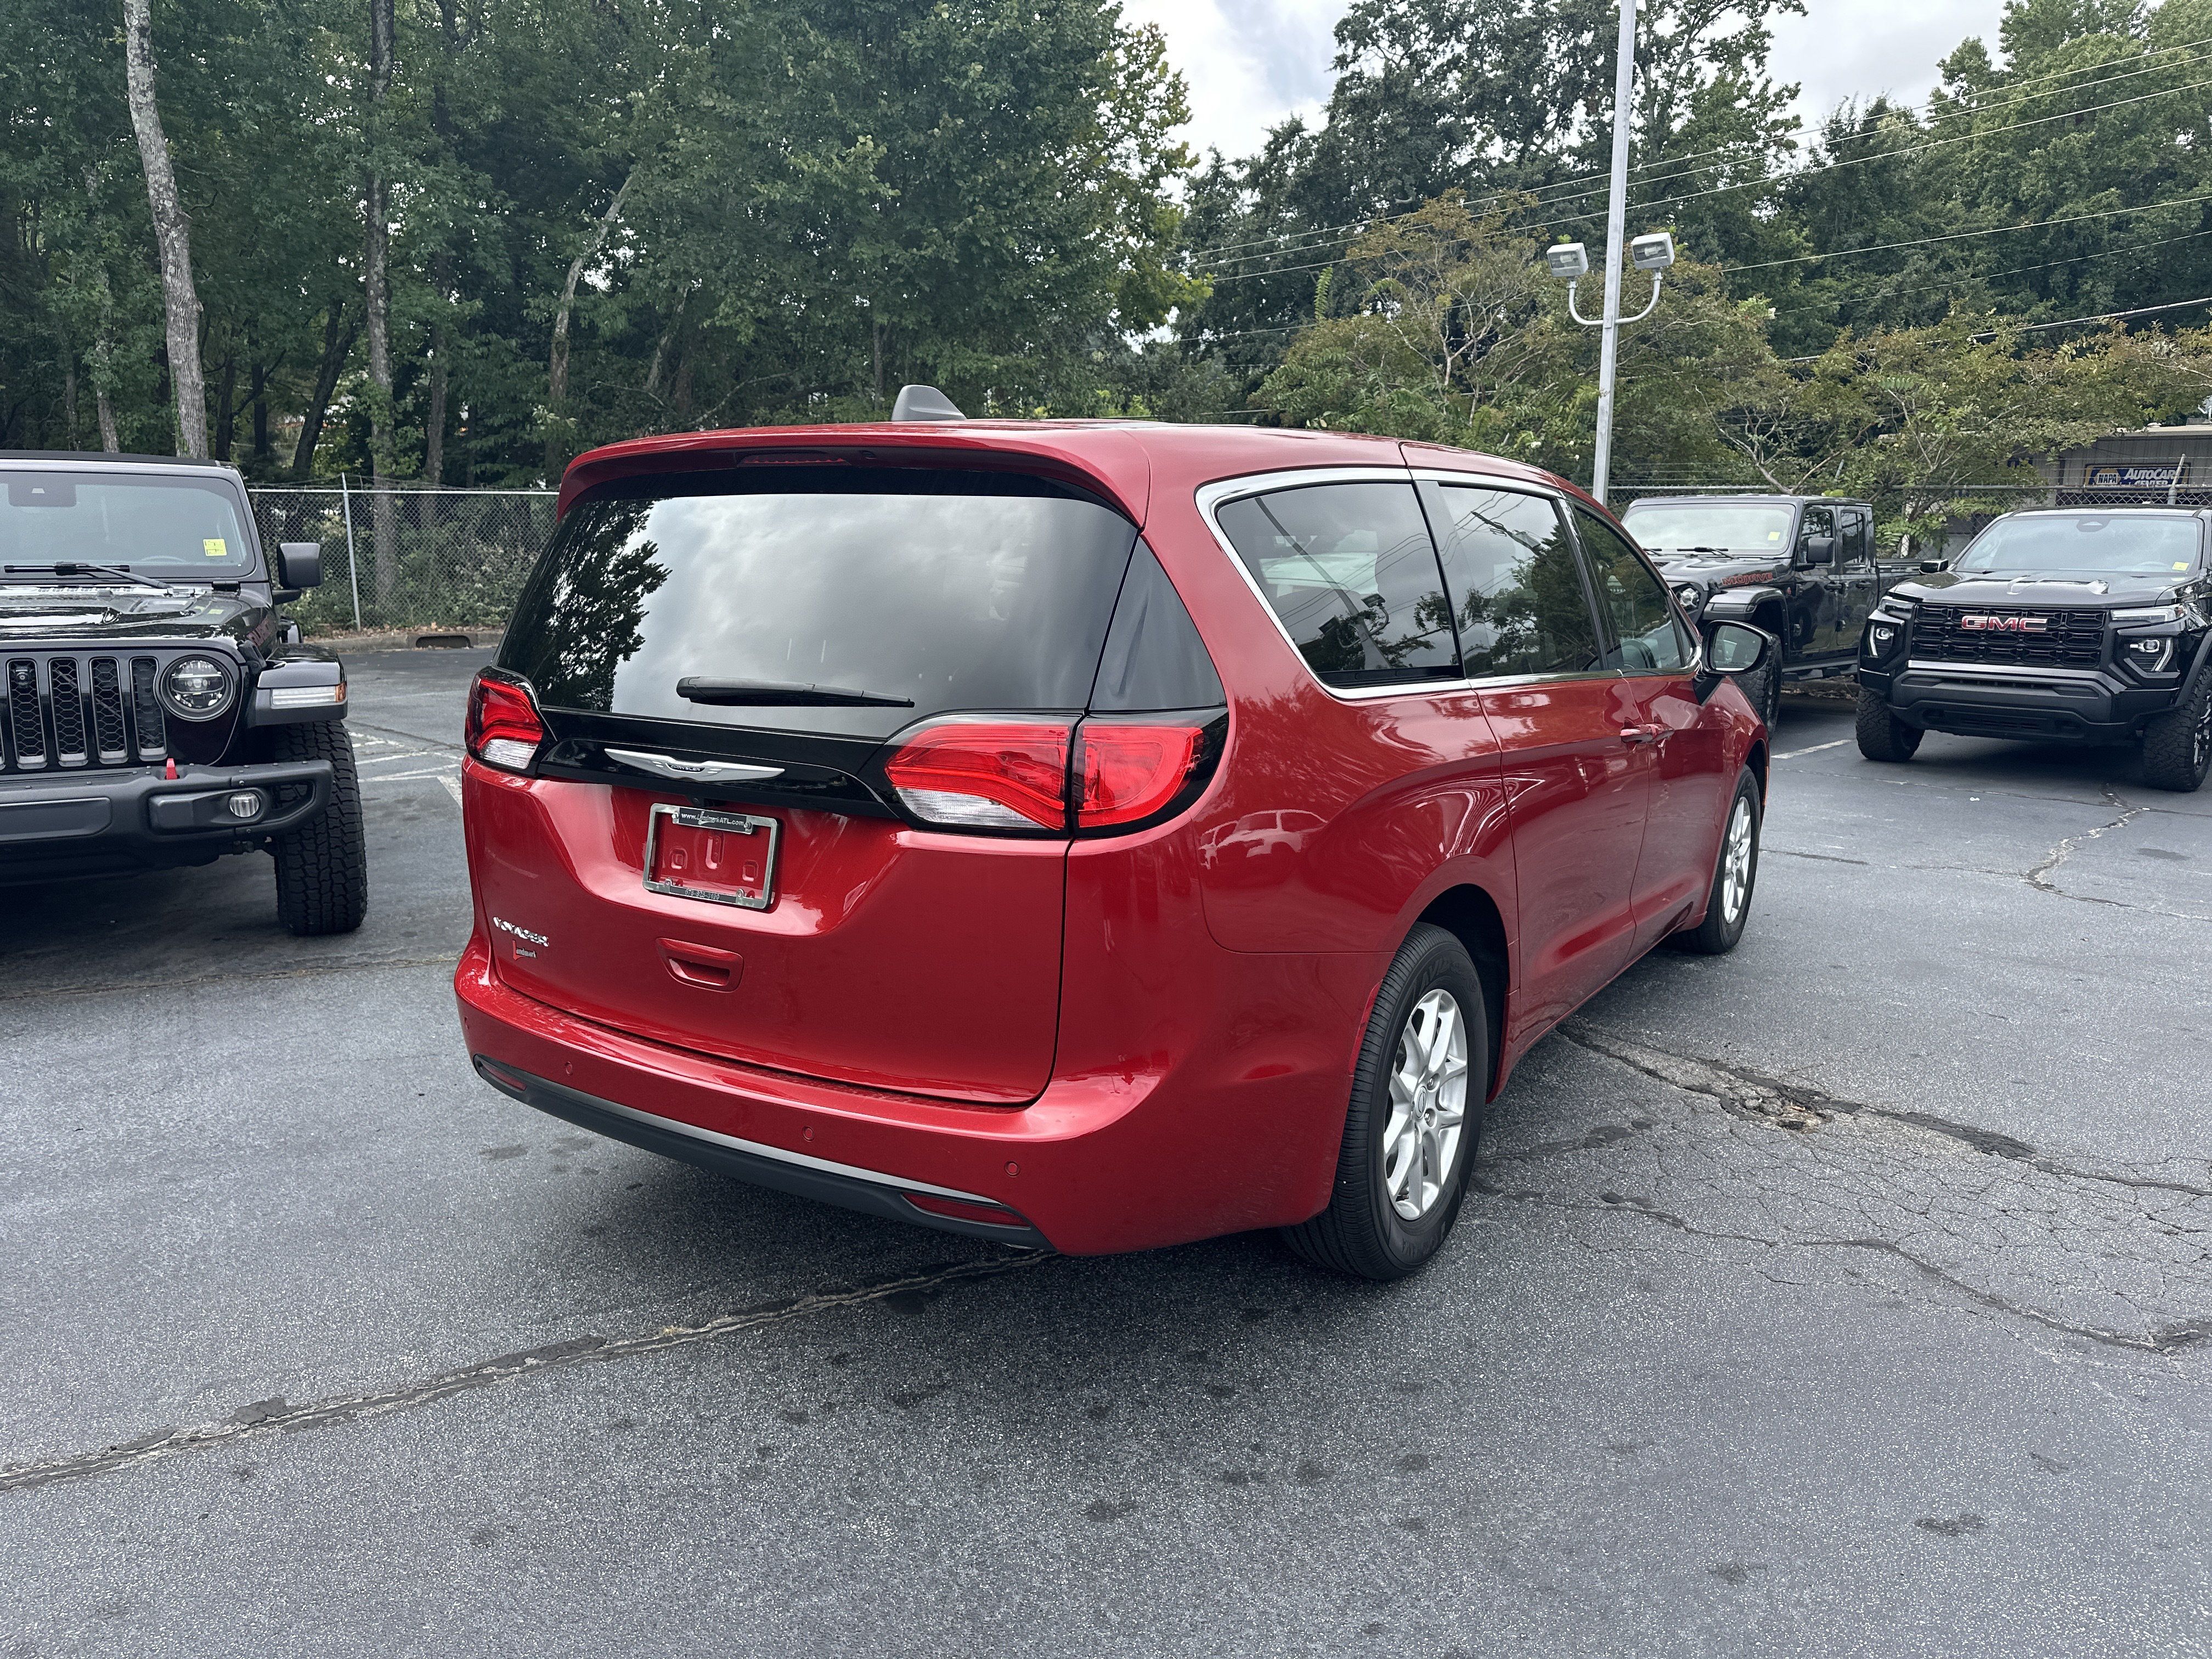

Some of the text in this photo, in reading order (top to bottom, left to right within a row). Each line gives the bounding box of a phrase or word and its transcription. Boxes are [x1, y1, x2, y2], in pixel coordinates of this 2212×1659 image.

[2098, 473, 2118, 483] NAPA
[2124, 469, 2180, 480] AUTOCAR
[1720, 573, 1773, 585] MOJAVE
[1961, 615, 2047, 633] GMC
